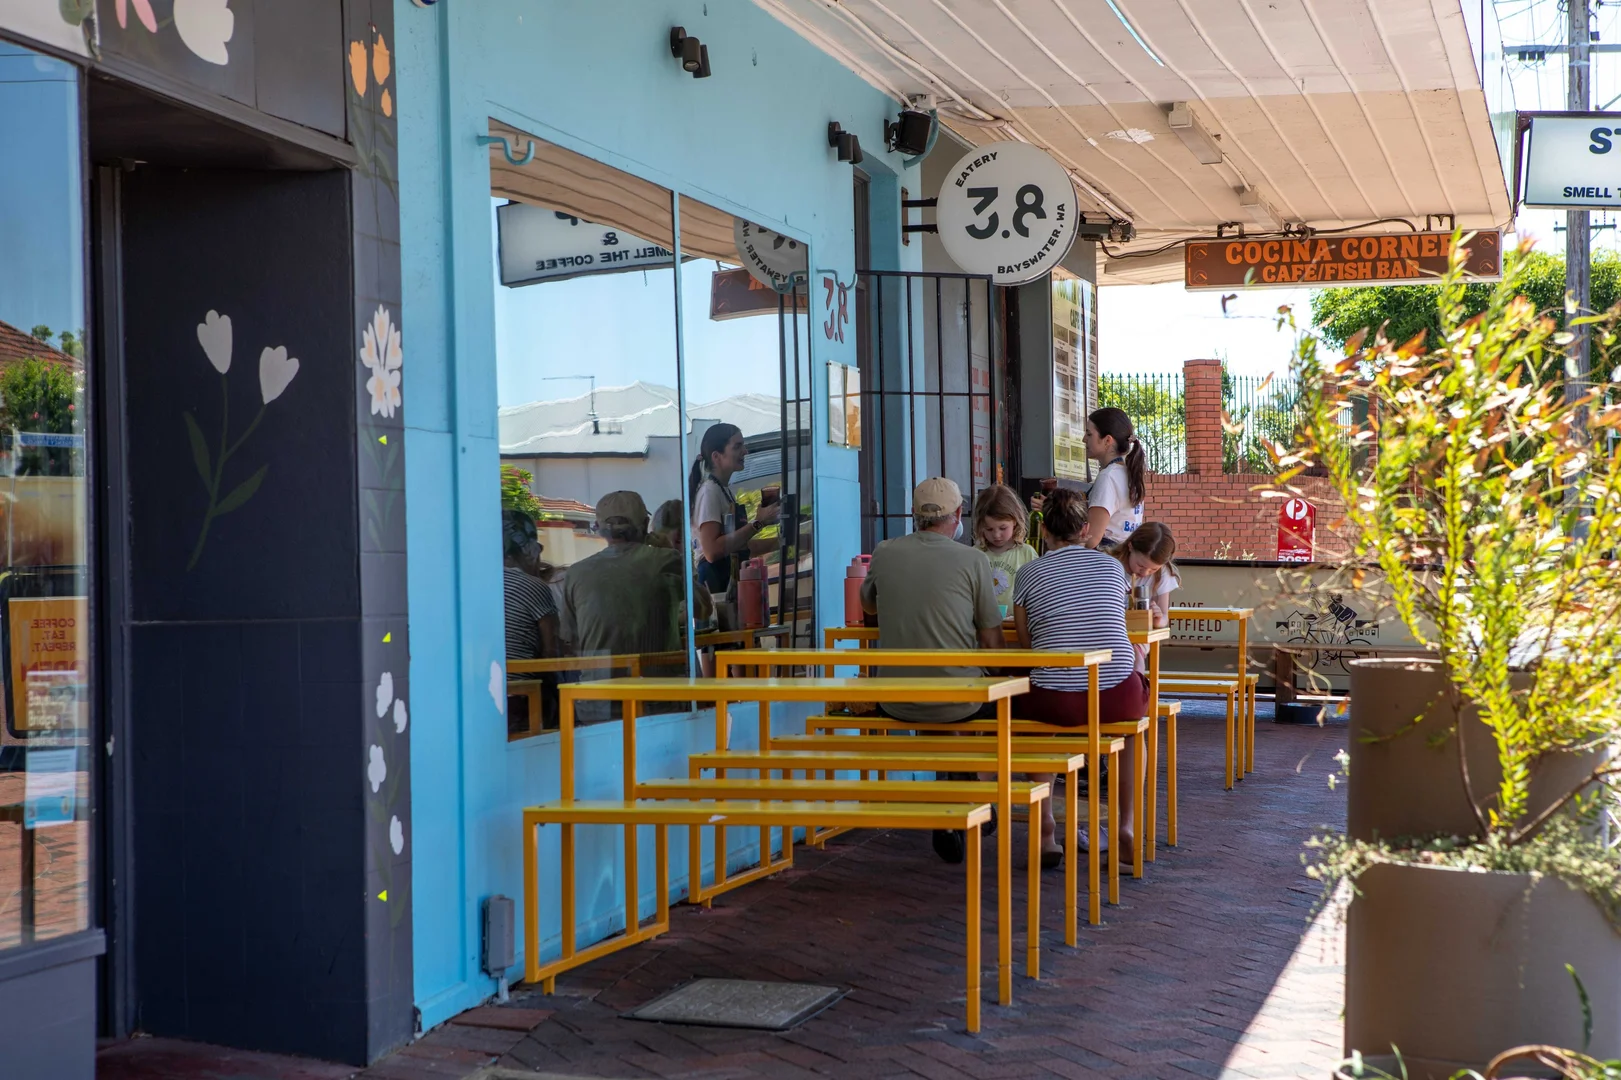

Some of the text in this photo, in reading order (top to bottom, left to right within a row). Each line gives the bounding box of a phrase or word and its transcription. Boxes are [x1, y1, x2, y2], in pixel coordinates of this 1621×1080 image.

[955, 152, 998, 188] EATERY
[1563, 186, 1612, 198] SMELL
[965, 184, 1047, 240] 3.8
[1056, 203, 1065, 221] WA
[1225, 239, 1333, 265] COCINA
[1376, 260, 1420, 278] BAR
